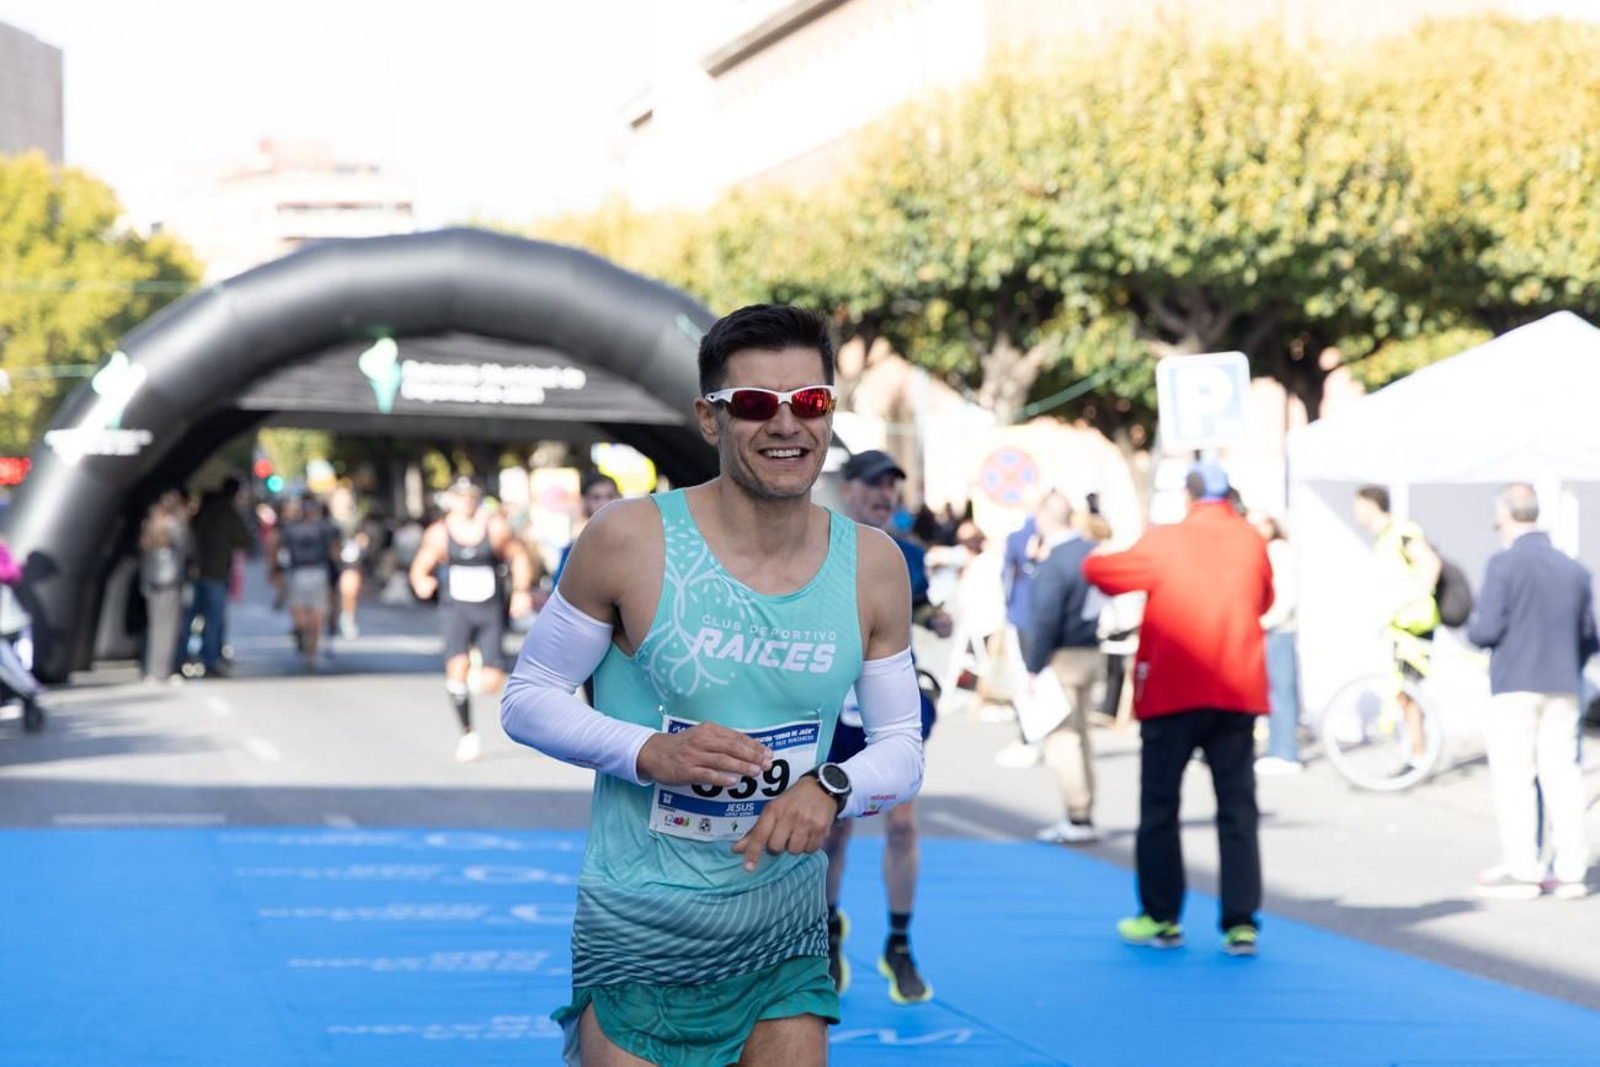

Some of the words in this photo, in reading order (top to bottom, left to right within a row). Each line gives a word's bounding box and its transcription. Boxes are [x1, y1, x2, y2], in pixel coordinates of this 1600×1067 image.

[702, 614, 741, 631] CLUB
[750, 624, 837, 641] DEPORTIVO
[691, 627, 837, 674] RAICES
[726, 802, 755, 812] JESUS
